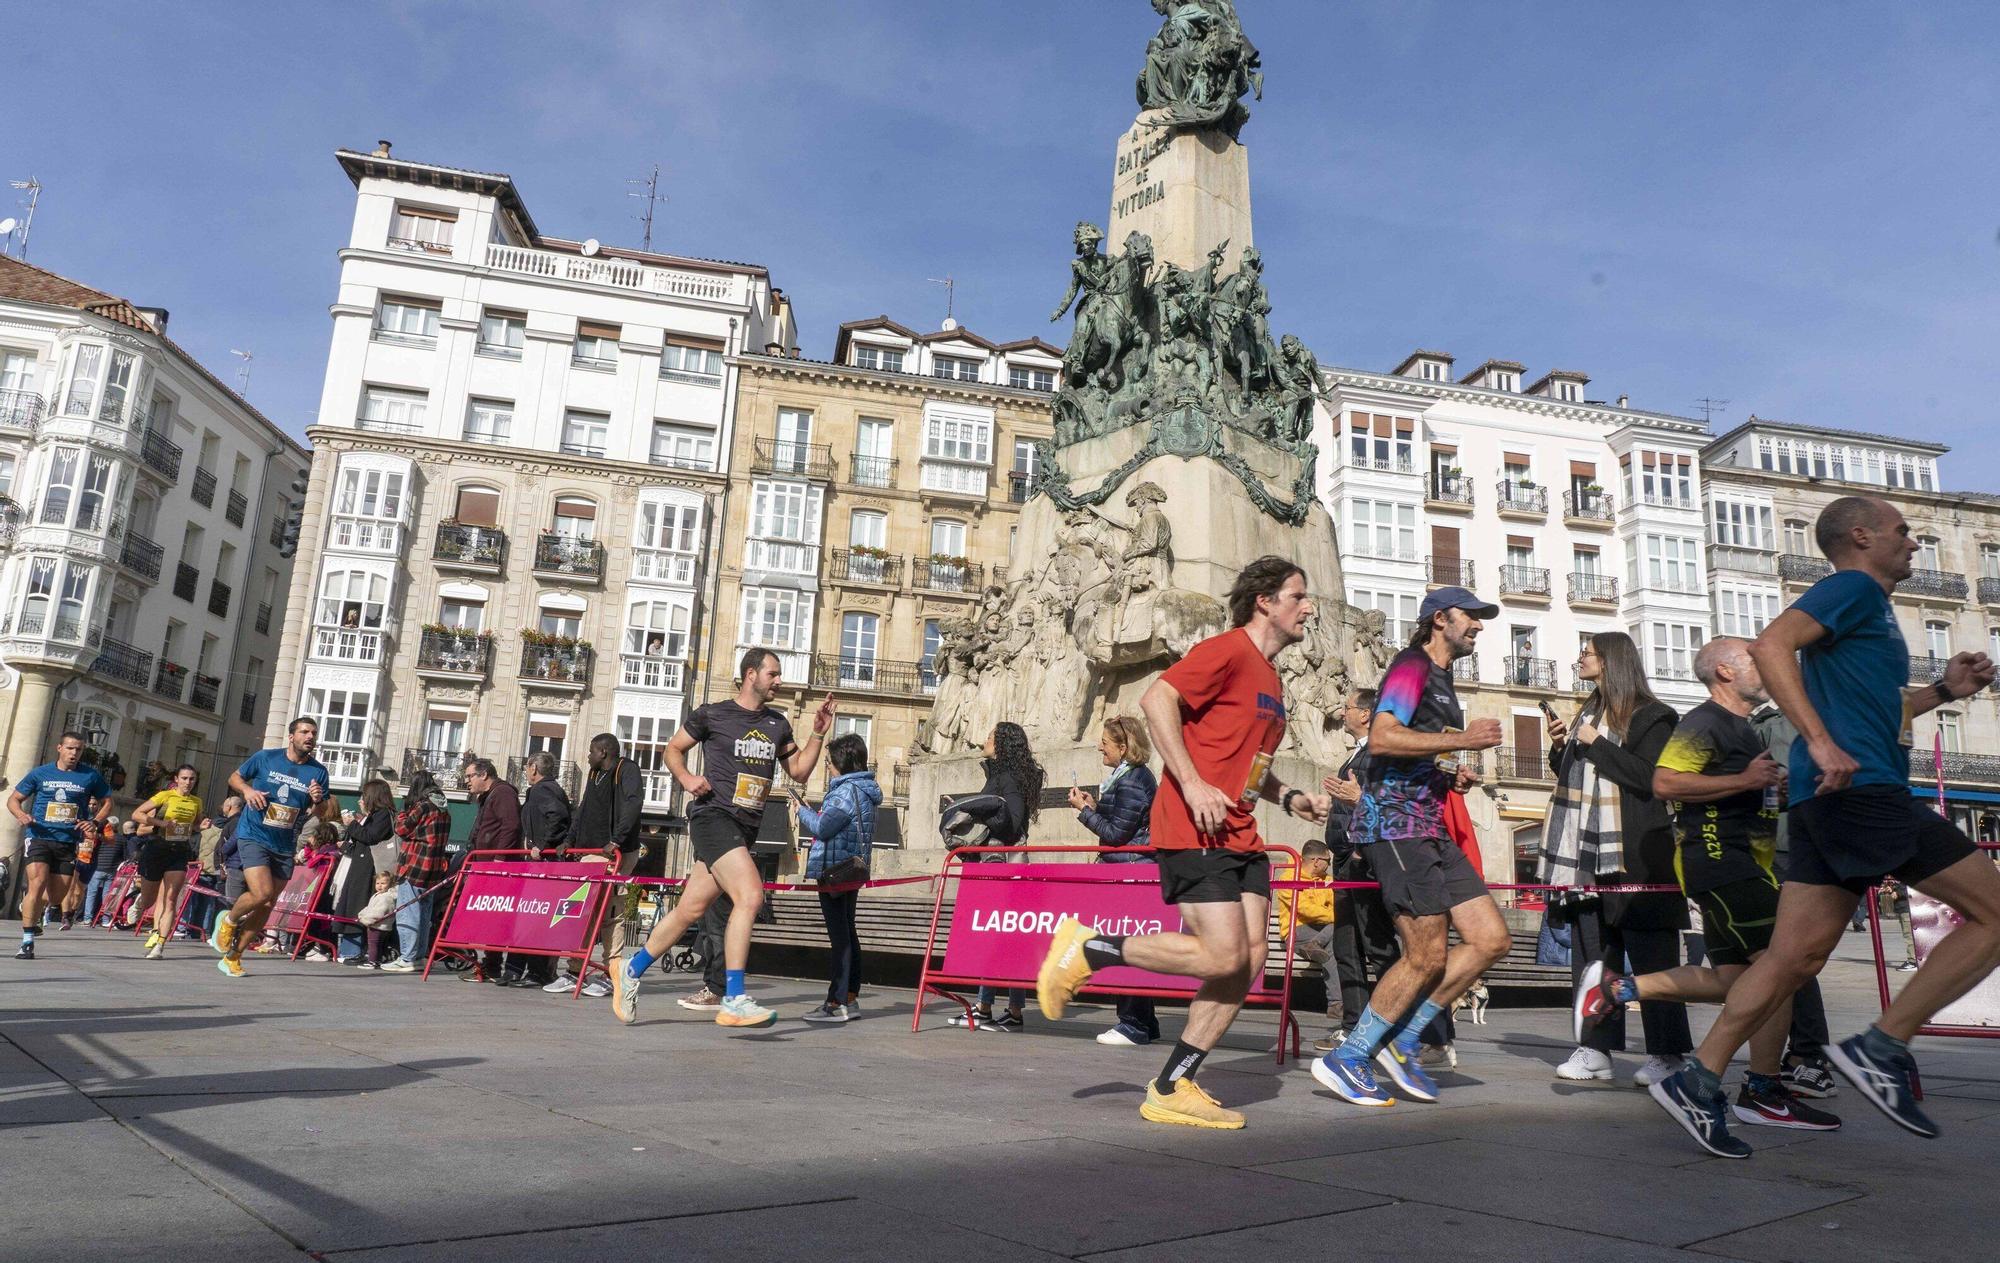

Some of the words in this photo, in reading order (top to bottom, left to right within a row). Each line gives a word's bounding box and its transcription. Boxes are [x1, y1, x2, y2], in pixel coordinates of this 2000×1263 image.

[1132, 129, 1138, 143] A
[1135, 168, 1149, 186] DE
[1118, 180, 1164, 219] VITORIA
[745, 758, 766, 766] TRAIL
[466, 894, 515, 912] LABORAL
[516, 897, 551, 915] kutxa
[971, 909, 1079, 934] LABORA
[1092, 914, 1163, 937] kutxa
